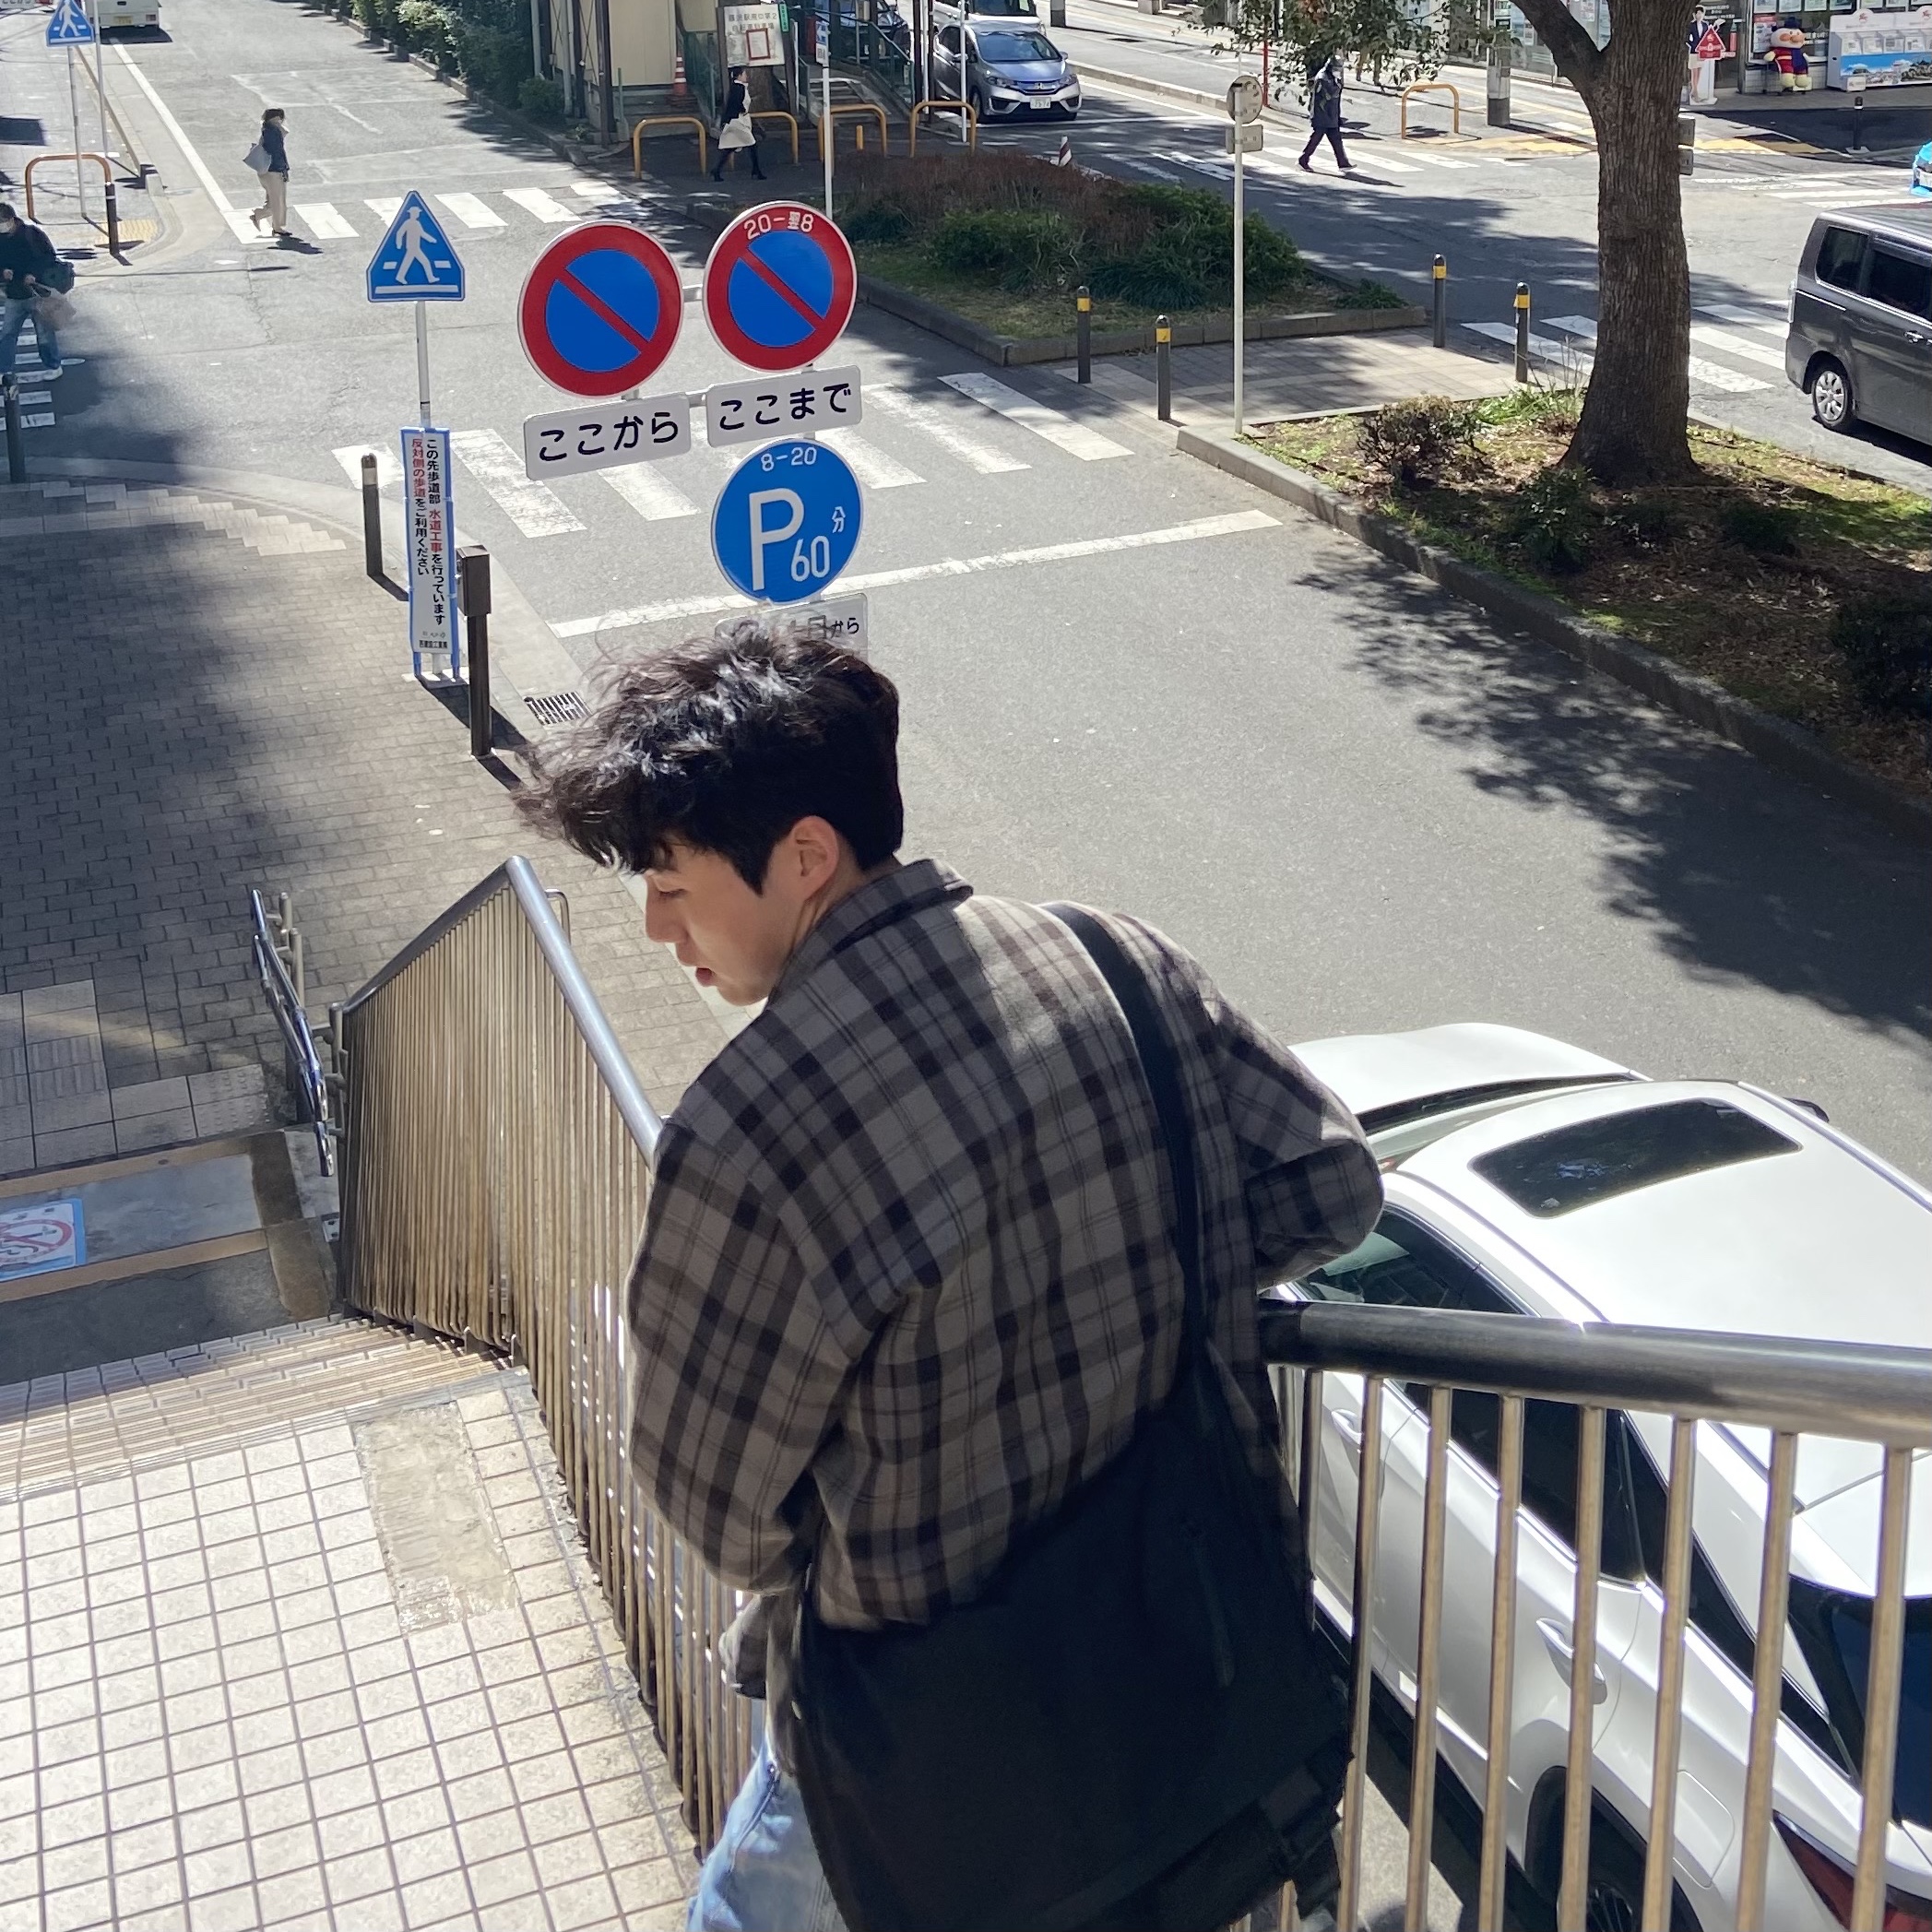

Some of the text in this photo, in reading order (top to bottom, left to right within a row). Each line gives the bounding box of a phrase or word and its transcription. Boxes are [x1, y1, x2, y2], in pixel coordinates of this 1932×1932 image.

[718, 382, 852, 431] ここまで
[538, 411, 679, 462] ここから
[760, 446, 818, 472] 8-20
[411, 438, 430, 575] 反対側の歩道をご利用ください
[749, 487, 805, 591] P
[790, 535, 830, 582] 60
